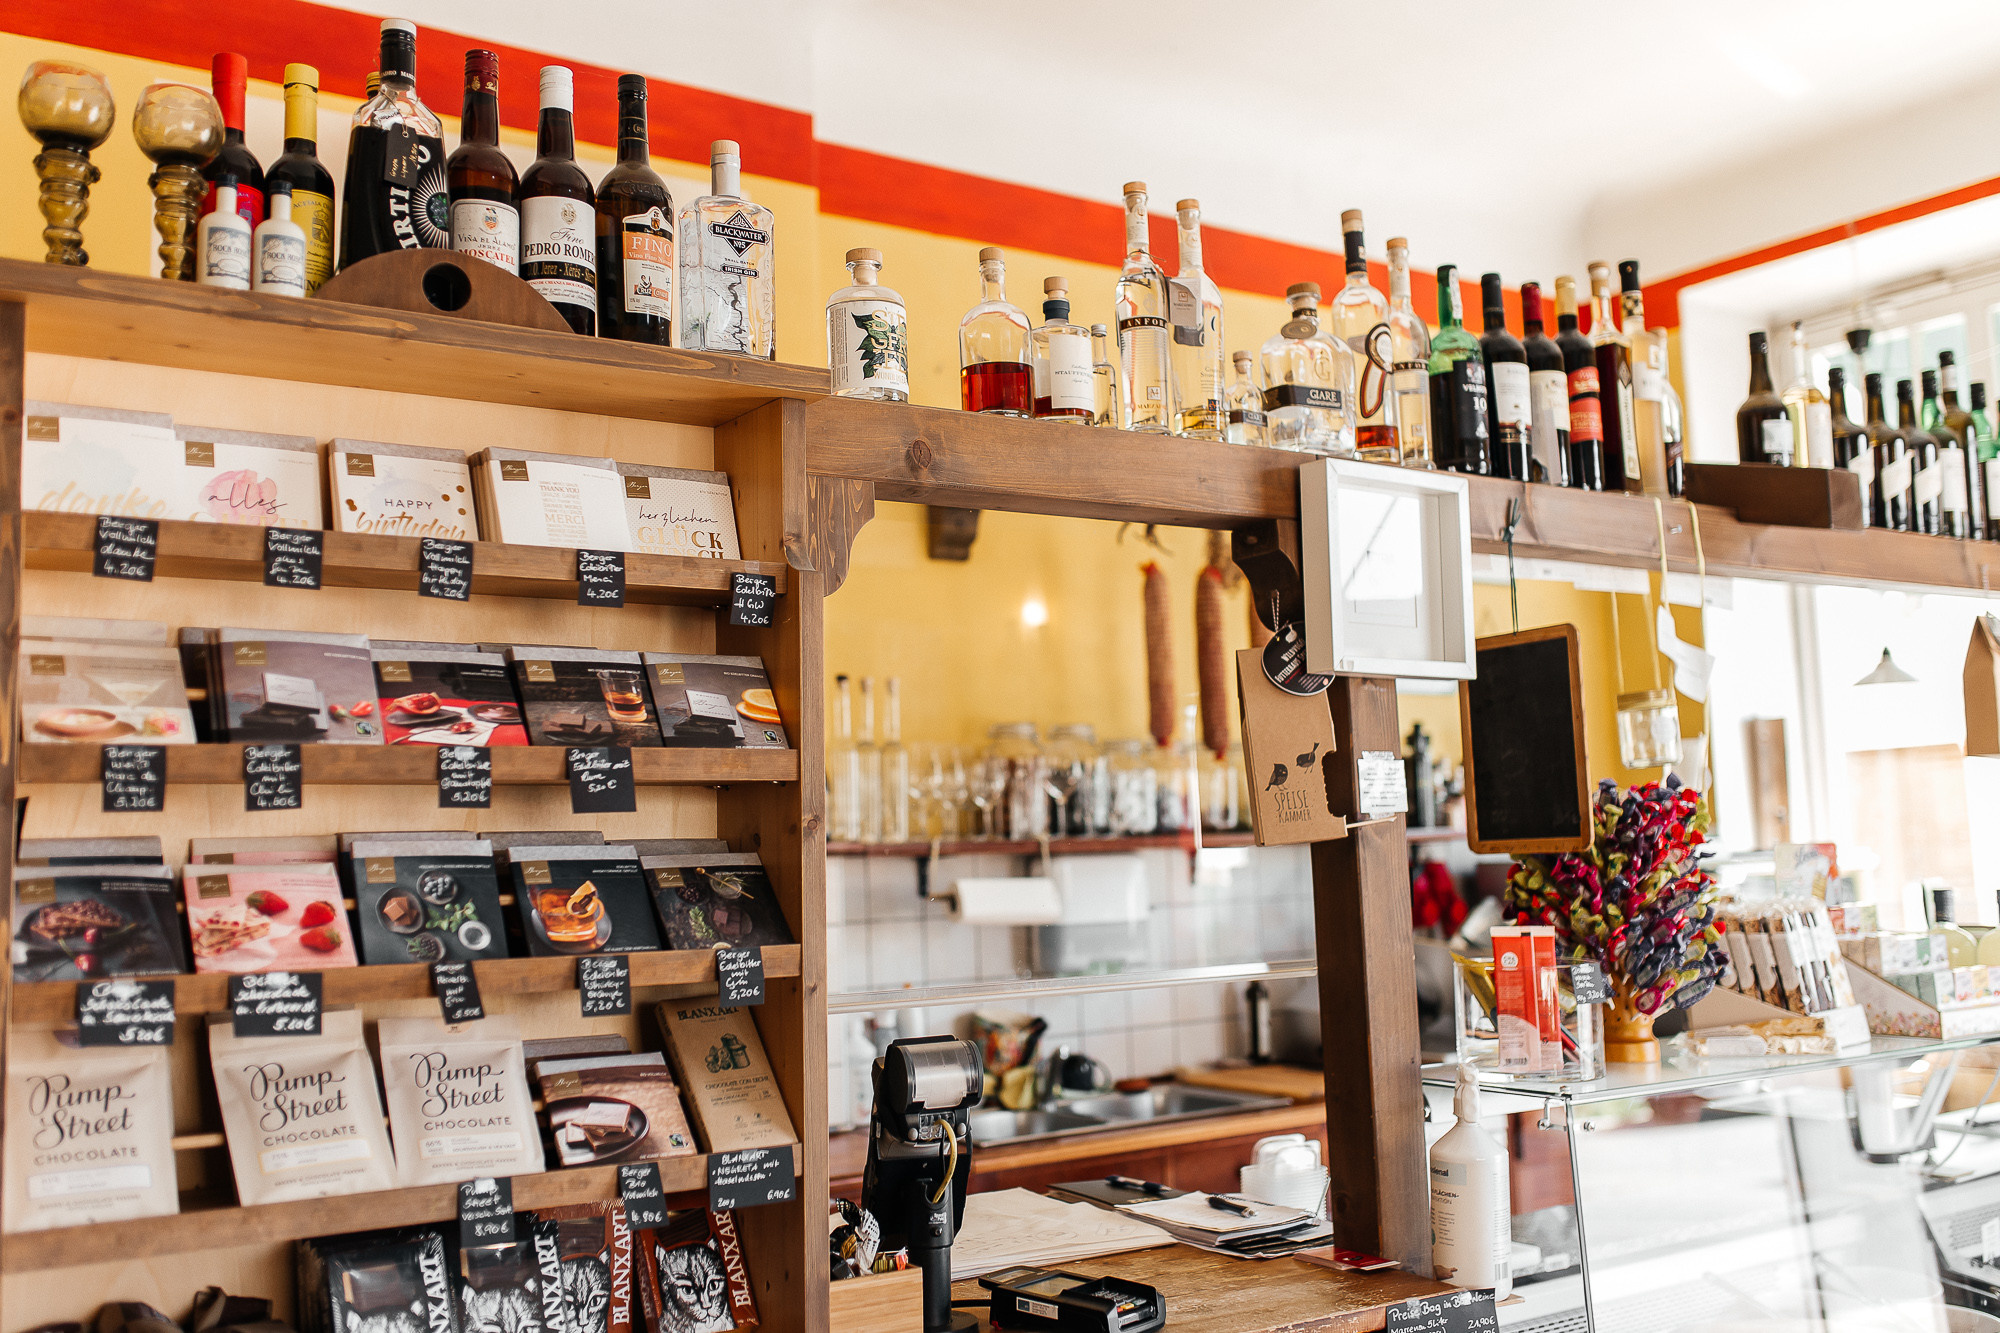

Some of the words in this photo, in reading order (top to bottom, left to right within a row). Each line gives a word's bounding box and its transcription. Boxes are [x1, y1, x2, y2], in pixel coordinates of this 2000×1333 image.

[457, 233, 477, 243] VIÑA
[550, 227, 584, 244] Fino
[715, 225, 765, 243] BLACKWATER
[266, 251, 286, 260] ROCK
[523, 242, 561, 258] PEDRO
[629, 251, 644, 259] Vino
[631, 236, 672, 258] FINO
[458, 248, 516, 266] MOSCATEL
[540, 262, 557, 275] Jerez
[724, 266, 743, 275] IRISH
[744, 268, 756, 277] GIN
[1473, 396, 1488, 412] 10
[540, 485, 564, 493] THANK
[207, 481, 288, 515] alles
[384, 498, 433, 510] HAPPY
[544, 512, 585, 525] MERCI
[638, 504, 719, 528] herzlichen
[636, 523, 724, 550] GLÜCK
[427, 562, 463, 577] Happy
[735, 573, 768, 586] Berger
[1274, 789, 1309, 812] SPEISE
[1278, 808, 1312, 824] KAMMER
[716, 949, 751, 962] Berger
[730, 968, 750, 978] mit
[728, 985, 761, 1001] 5,20€
[409, 1051, 505, 1089] Pump
[243, 1062, 346, 1103] Pump
[25, 1073, 137, 1117] Pump
[421, 1082, 505, 1118] Street
[258, 1089, 348, 1133] Street
[32, 1106, 134, 1151] Street
[423, 1115, 513, 1132] CHOCOLATE
[262, 1124, 358, 1148] CHOCOLATE
[33, 1146, 139, 1167] CHOCOLATE
[621, 1167, 652, 1179] Berger
[611, 1210, 631, 1325] BLANXART
[715, 1209, 753, 1309] BLANXAR
[1388, 1306, 1421, 1322] Preise
[1420, 1300, 1442, 1316] Bag
[1443, 1300, 1452, 1309] in
